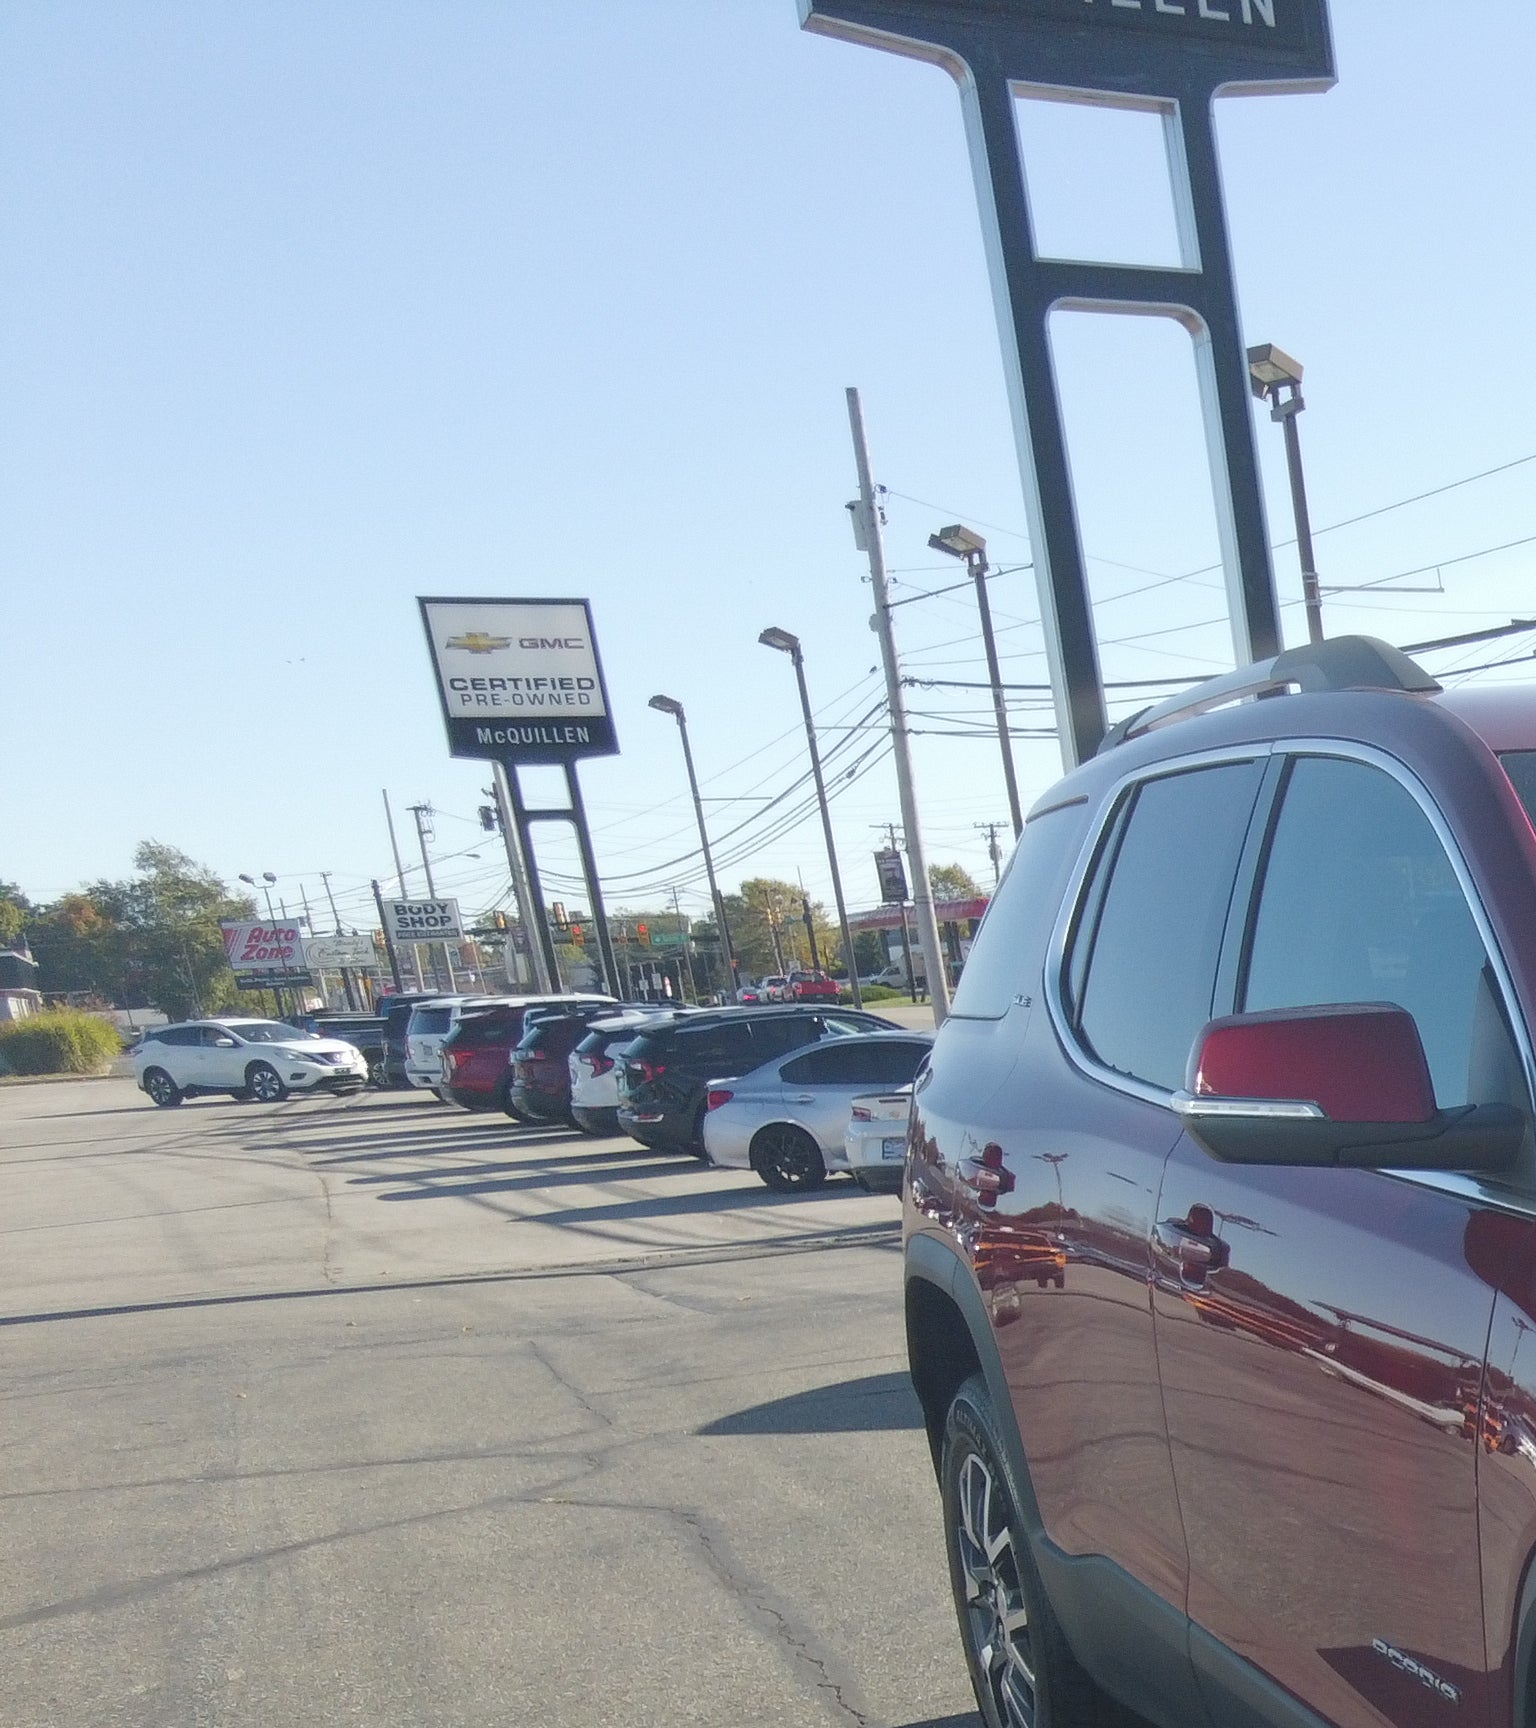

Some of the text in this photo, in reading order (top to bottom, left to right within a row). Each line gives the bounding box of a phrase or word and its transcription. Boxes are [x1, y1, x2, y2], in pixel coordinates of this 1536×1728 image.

[519, 638, 584, 649] GMC
[449, 677, 595, 691] CERTIFIED
[460, 692, 591, 706] PRE-OWNED
[476, 727, 590, 744] McQUILLEN
[394, 902, 449, 916] BODY
[397, 915, 452, 928] SHOP
[246, 926, 297, 943] Auto
[240, 944, 294, 961] Zone
